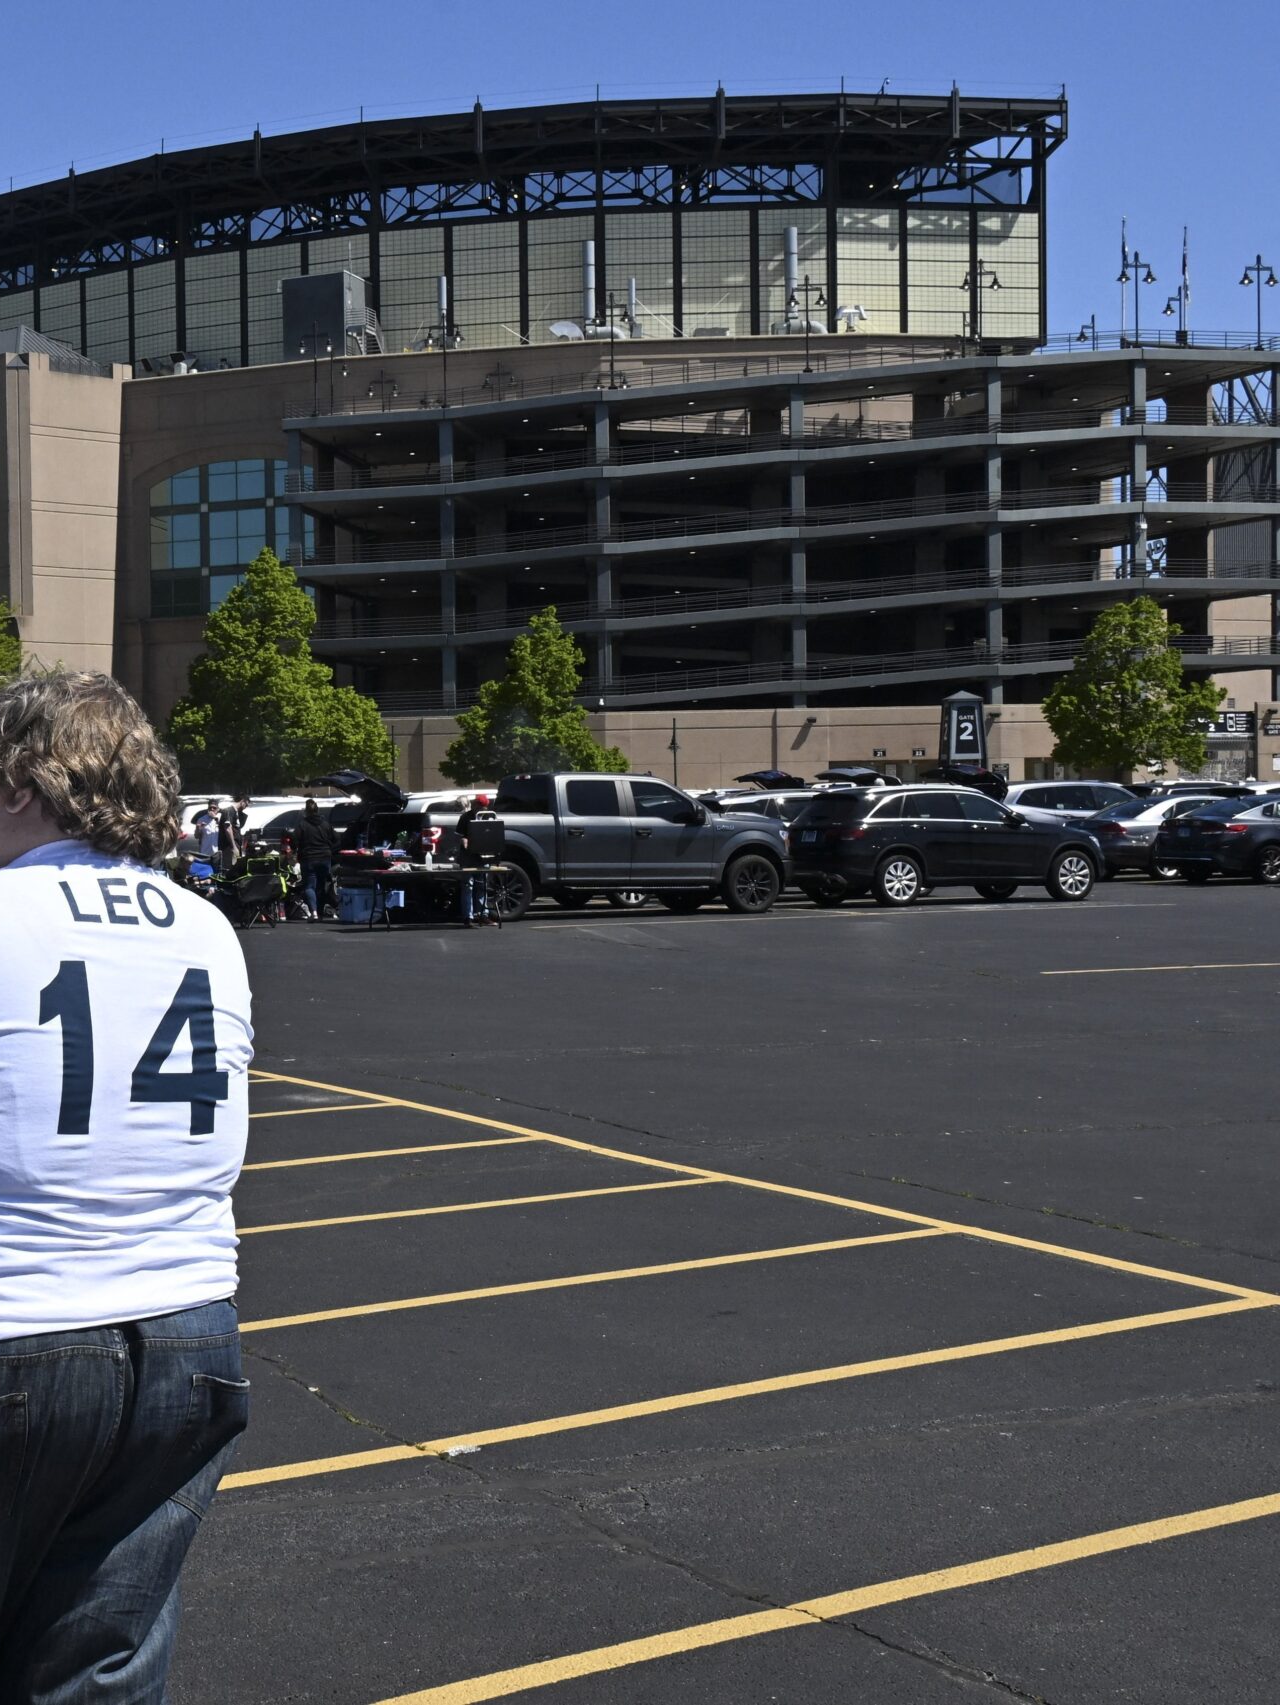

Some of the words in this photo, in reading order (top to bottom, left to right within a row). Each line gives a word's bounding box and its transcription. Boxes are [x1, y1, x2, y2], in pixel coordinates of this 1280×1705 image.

[959, 722, 974, 740] 2
[1209, 724, 1216, 732] 2
[58, 877, 175, 928] LEO
[38, 960, 229, 1136] 14
